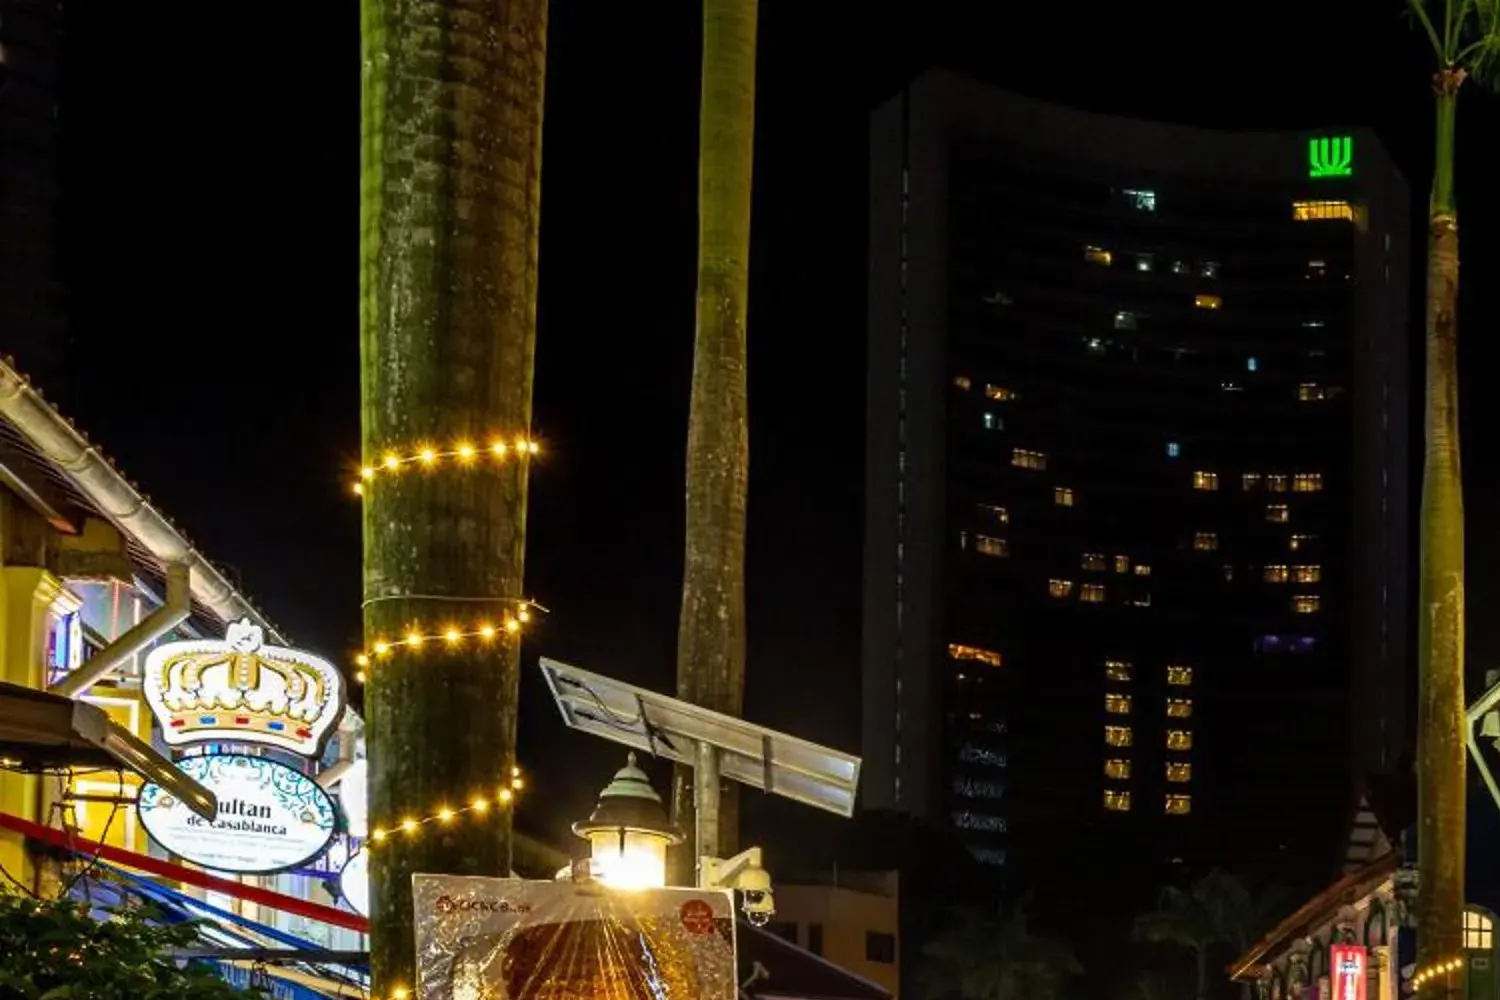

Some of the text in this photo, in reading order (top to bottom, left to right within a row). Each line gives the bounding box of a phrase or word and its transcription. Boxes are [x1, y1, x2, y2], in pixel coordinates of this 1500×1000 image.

[216, 797, 272, 819] ultan
[186, 816, 288, 836] de Casablanca
